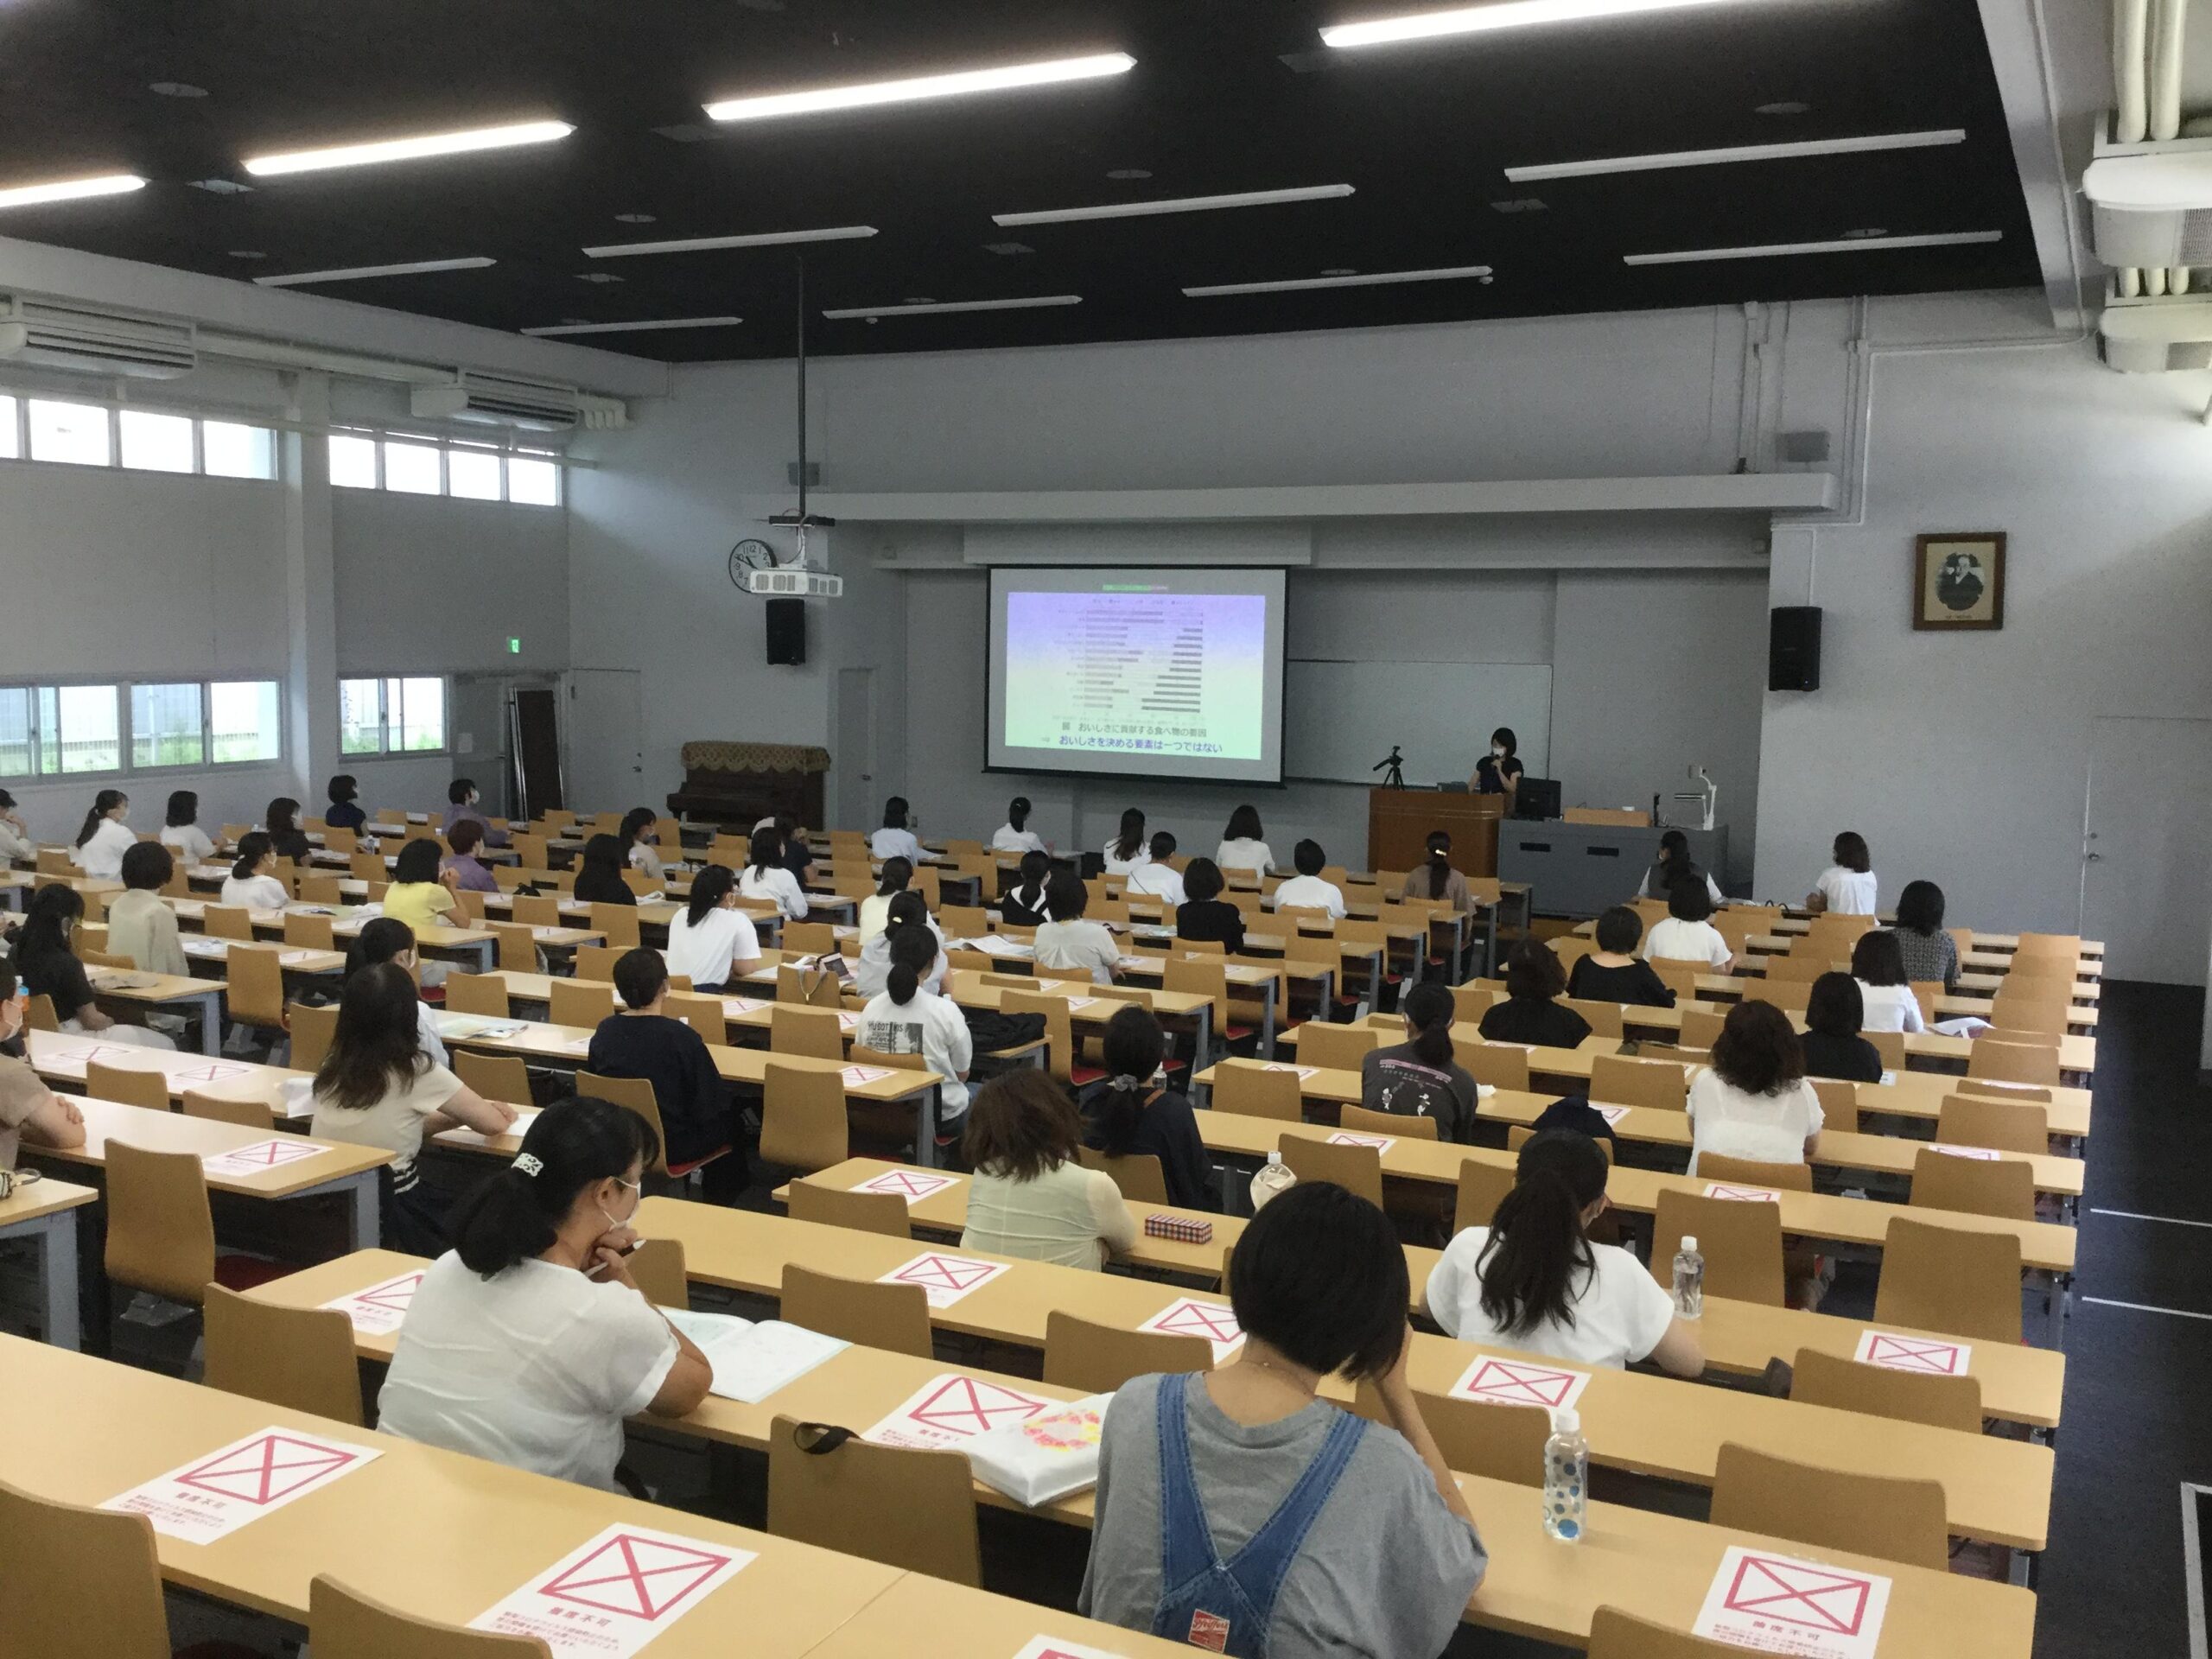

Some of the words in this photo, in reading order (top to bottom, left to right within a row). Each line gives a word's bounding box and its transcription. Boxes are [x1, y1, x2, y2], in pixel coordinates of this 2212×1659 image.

[743, 544, 749, 555] 11
[749, 544, 757, 553] 12
[762, 552, 768, 561] 2
[734, 562, 741, 571] 9
[743, 576, 748, 585] 7
[1059, 734, 1223, 753] おいしさを決める要素は一つではない
